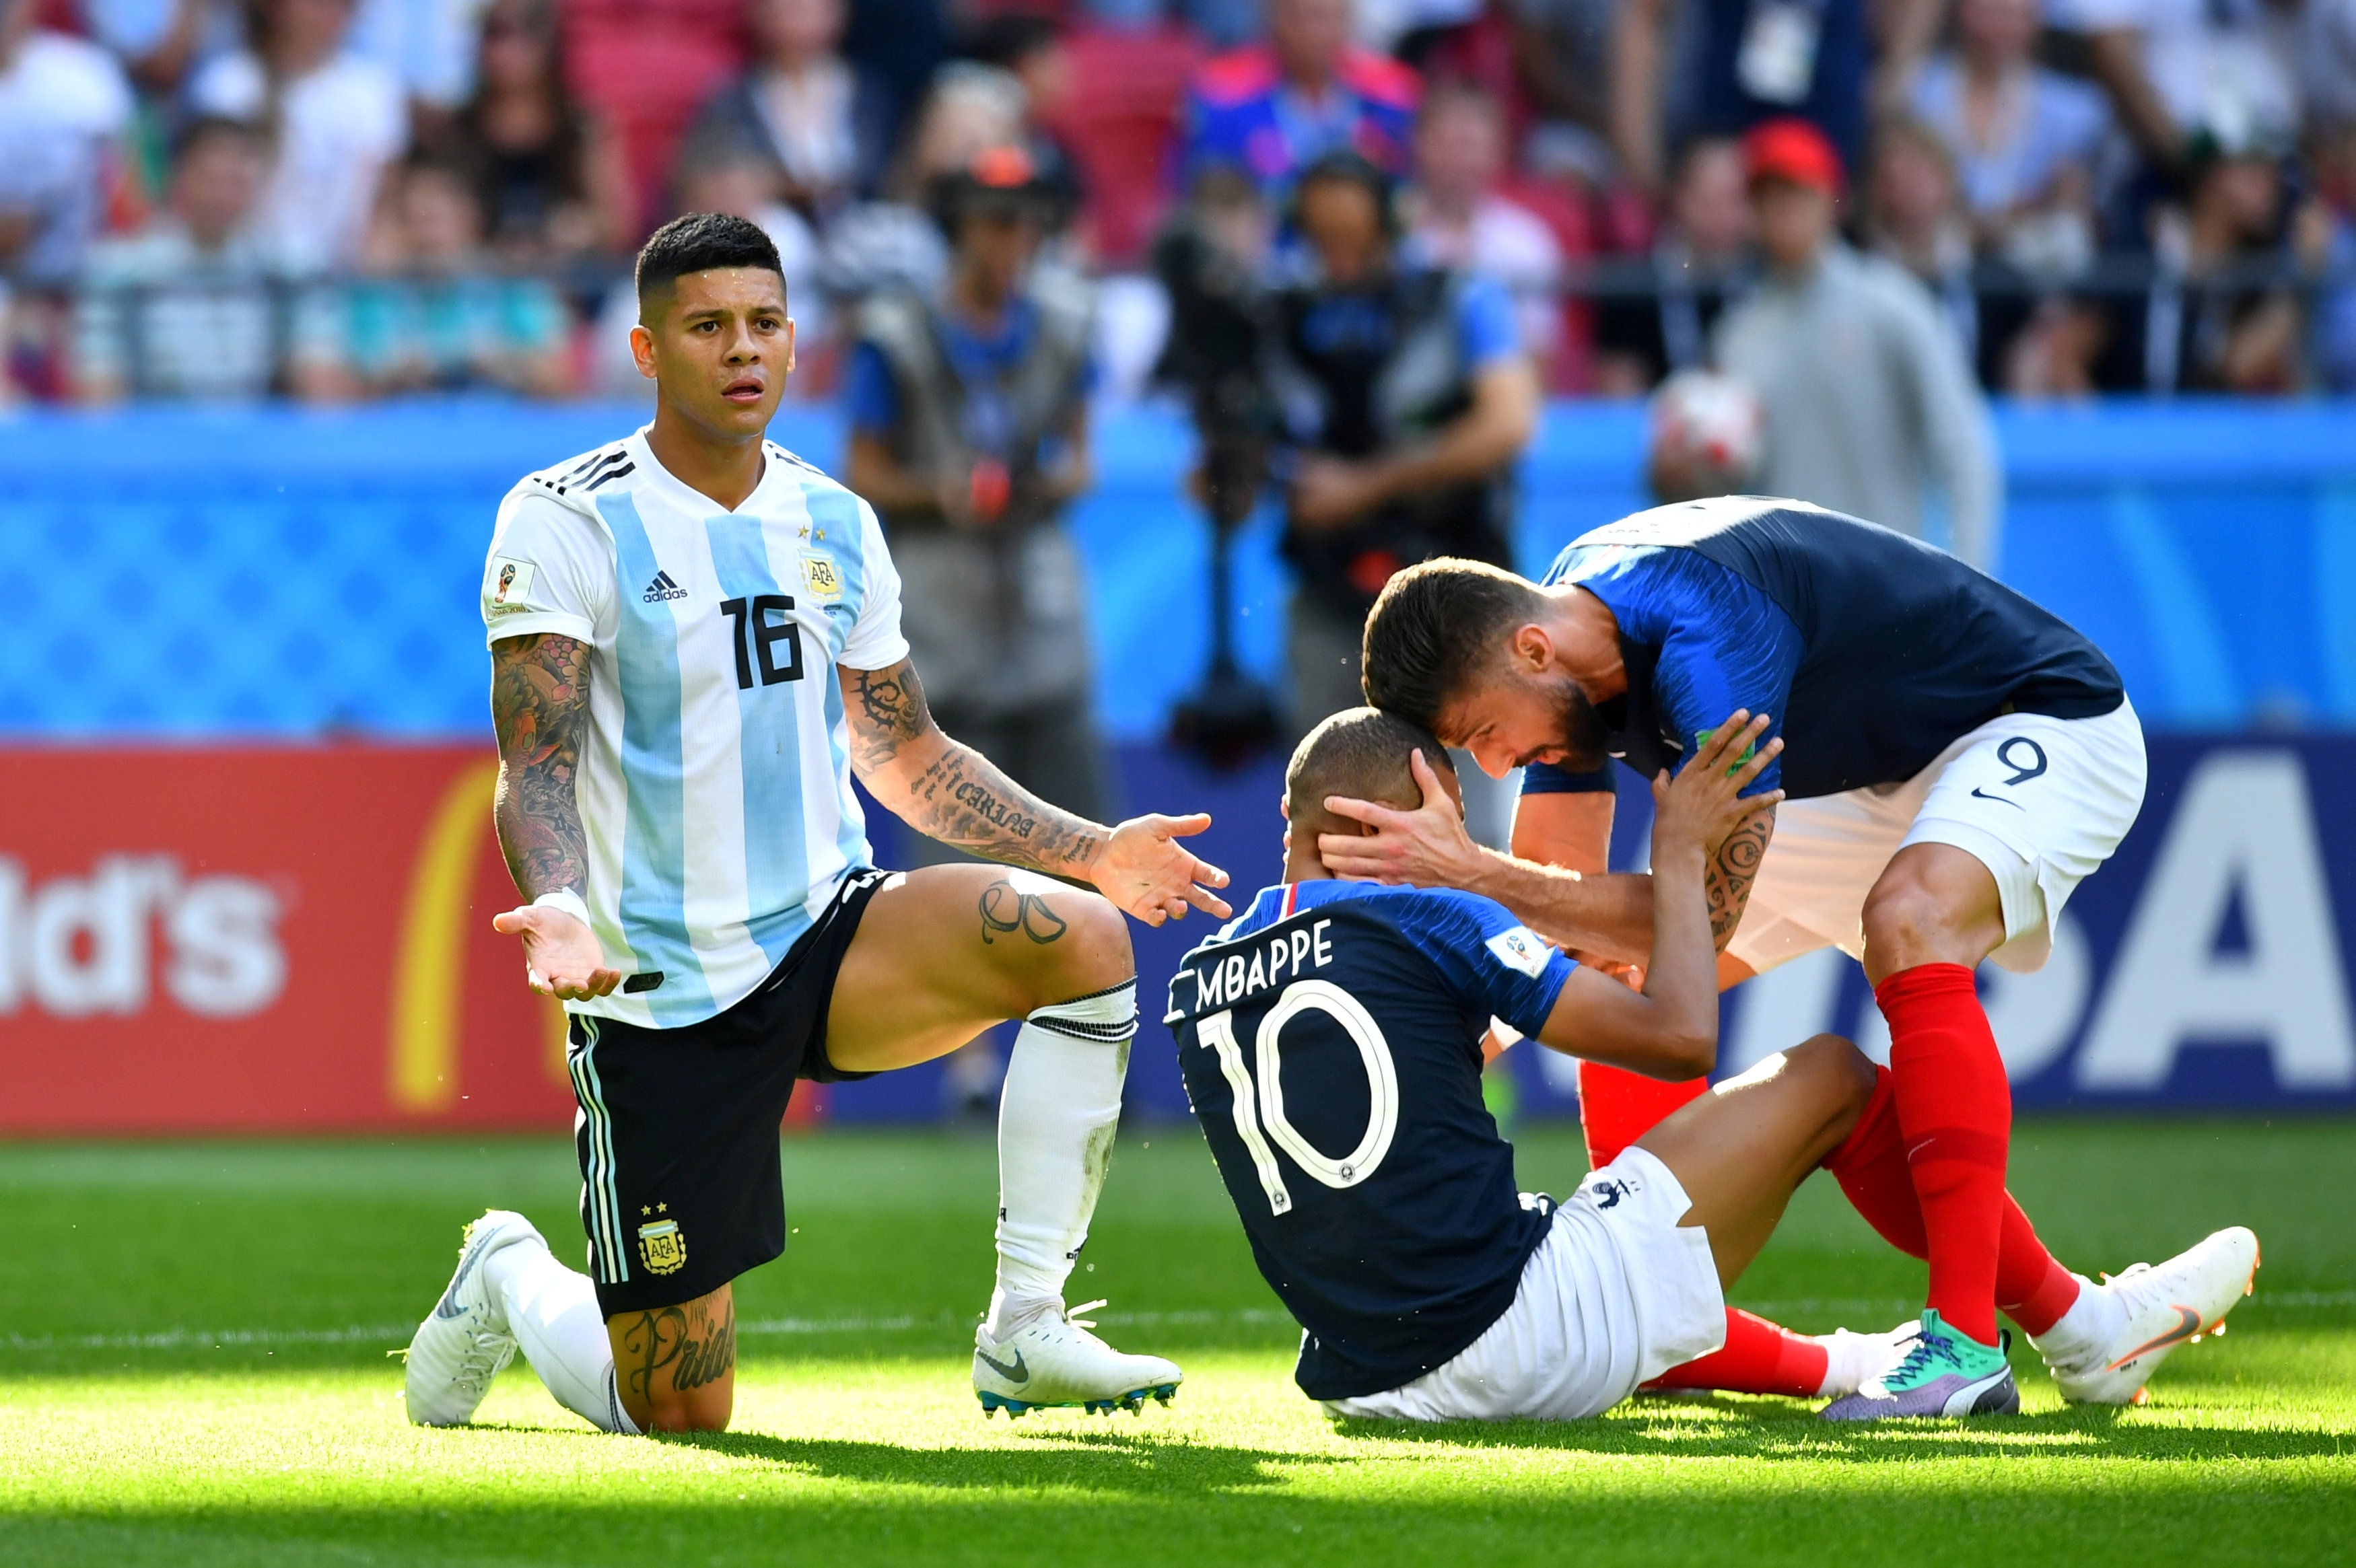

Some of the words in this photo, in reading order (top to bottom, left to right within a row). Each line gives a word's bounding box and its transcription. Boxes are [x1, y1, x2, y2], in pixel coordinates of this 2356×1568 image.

[642, 587, 688, 604] adidas
[720, 595, 804, 690] 16
[1997, 736, 2048, 786] 9
[1194, 918, 1333, 1012] MBAPPE
[1196, 978, 1399, 1217] 10
